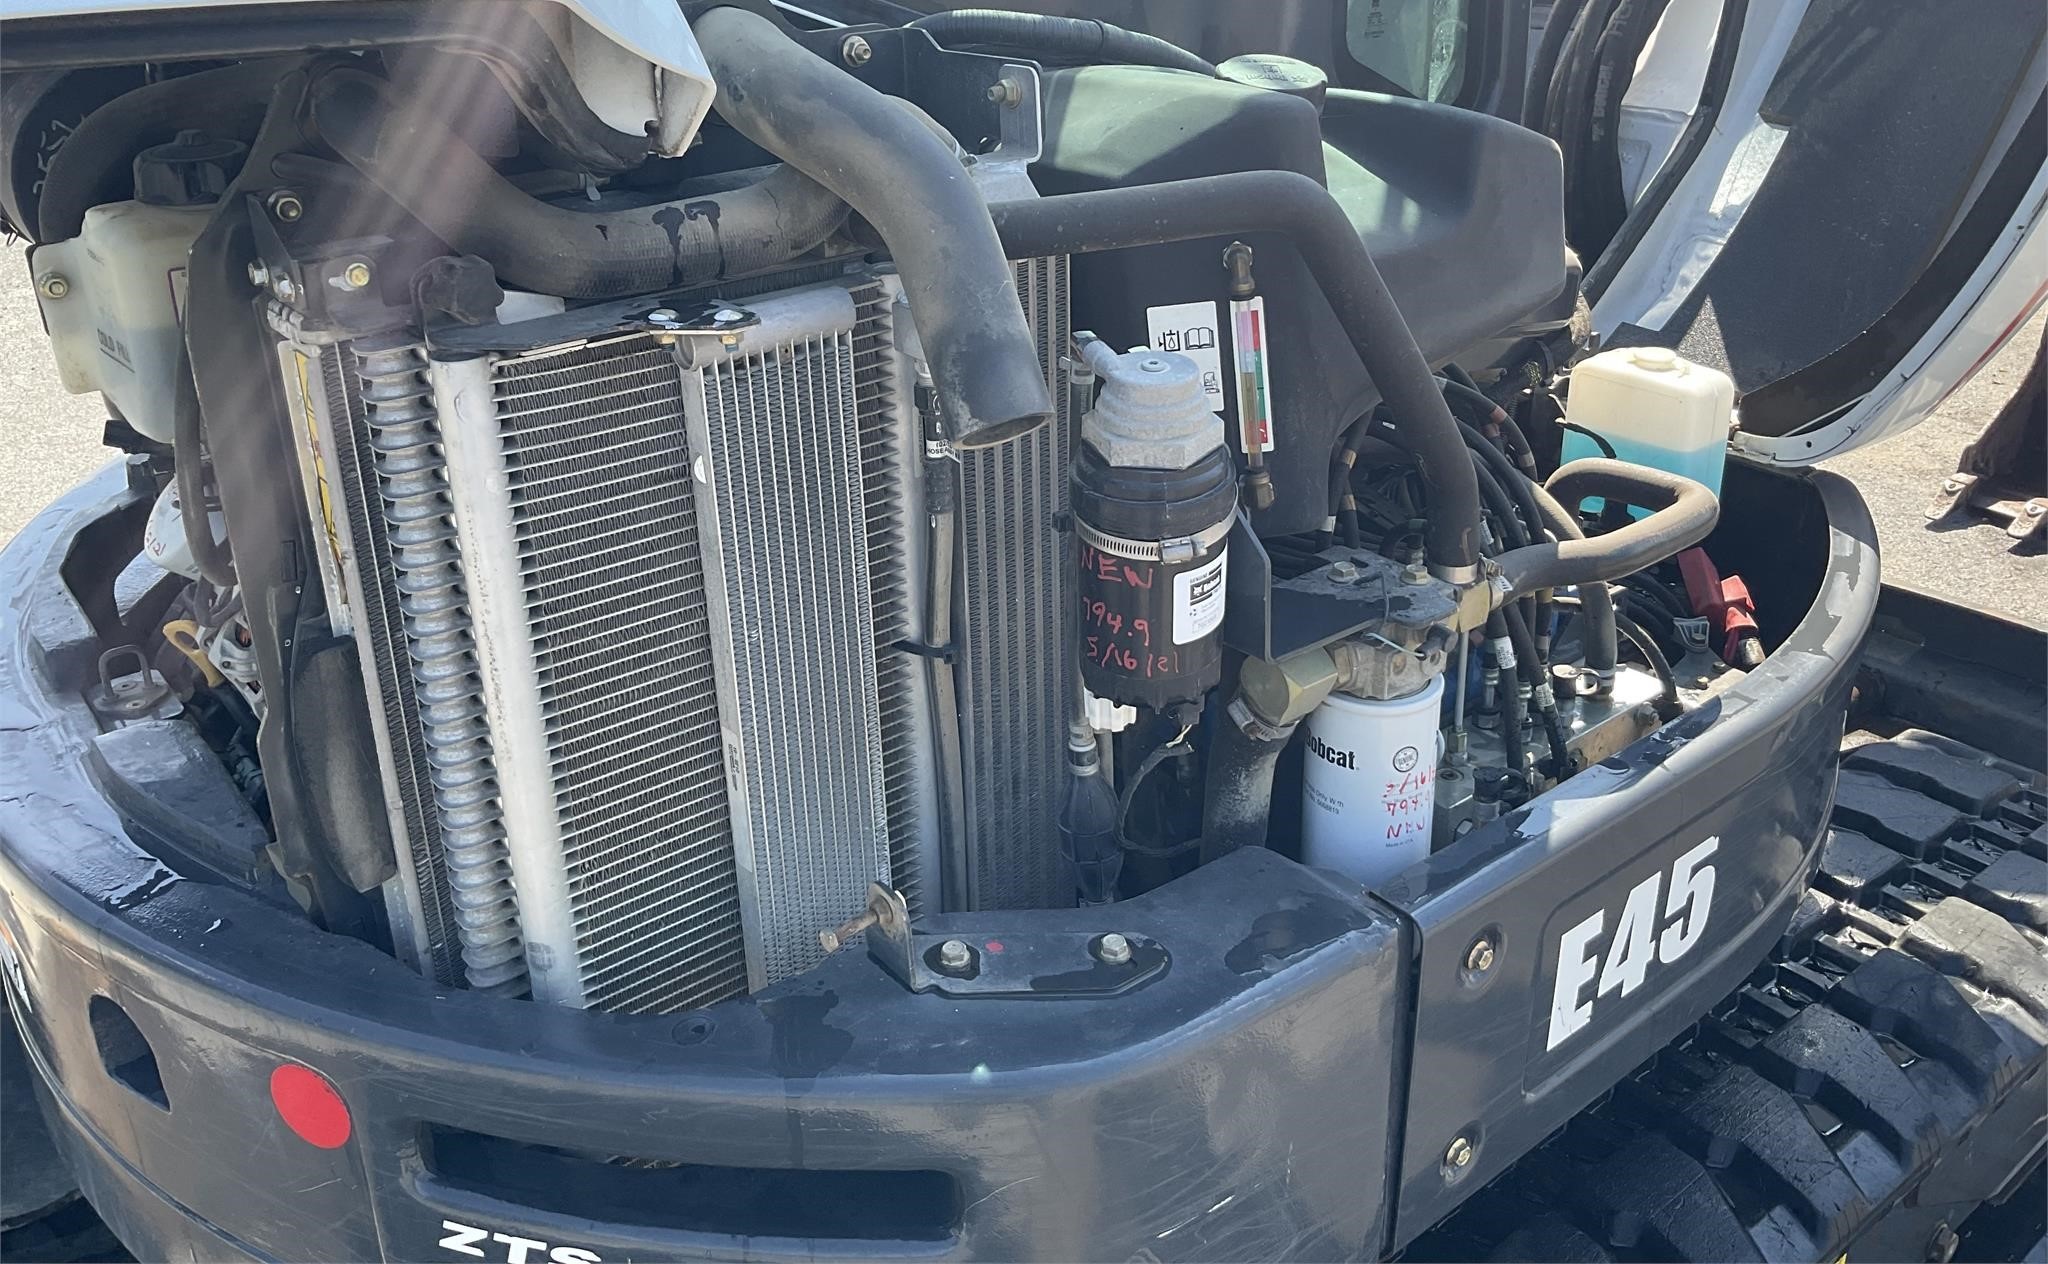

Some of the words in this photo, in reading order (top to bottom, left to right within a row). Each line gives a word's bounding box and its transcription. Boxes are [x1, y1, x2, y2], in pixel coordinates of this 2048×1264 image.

[1081, 546, 1153, 589] NEW
[1083, 596, 1150, 647] 794.9
[1546, 835, 1720, 1052] E45
